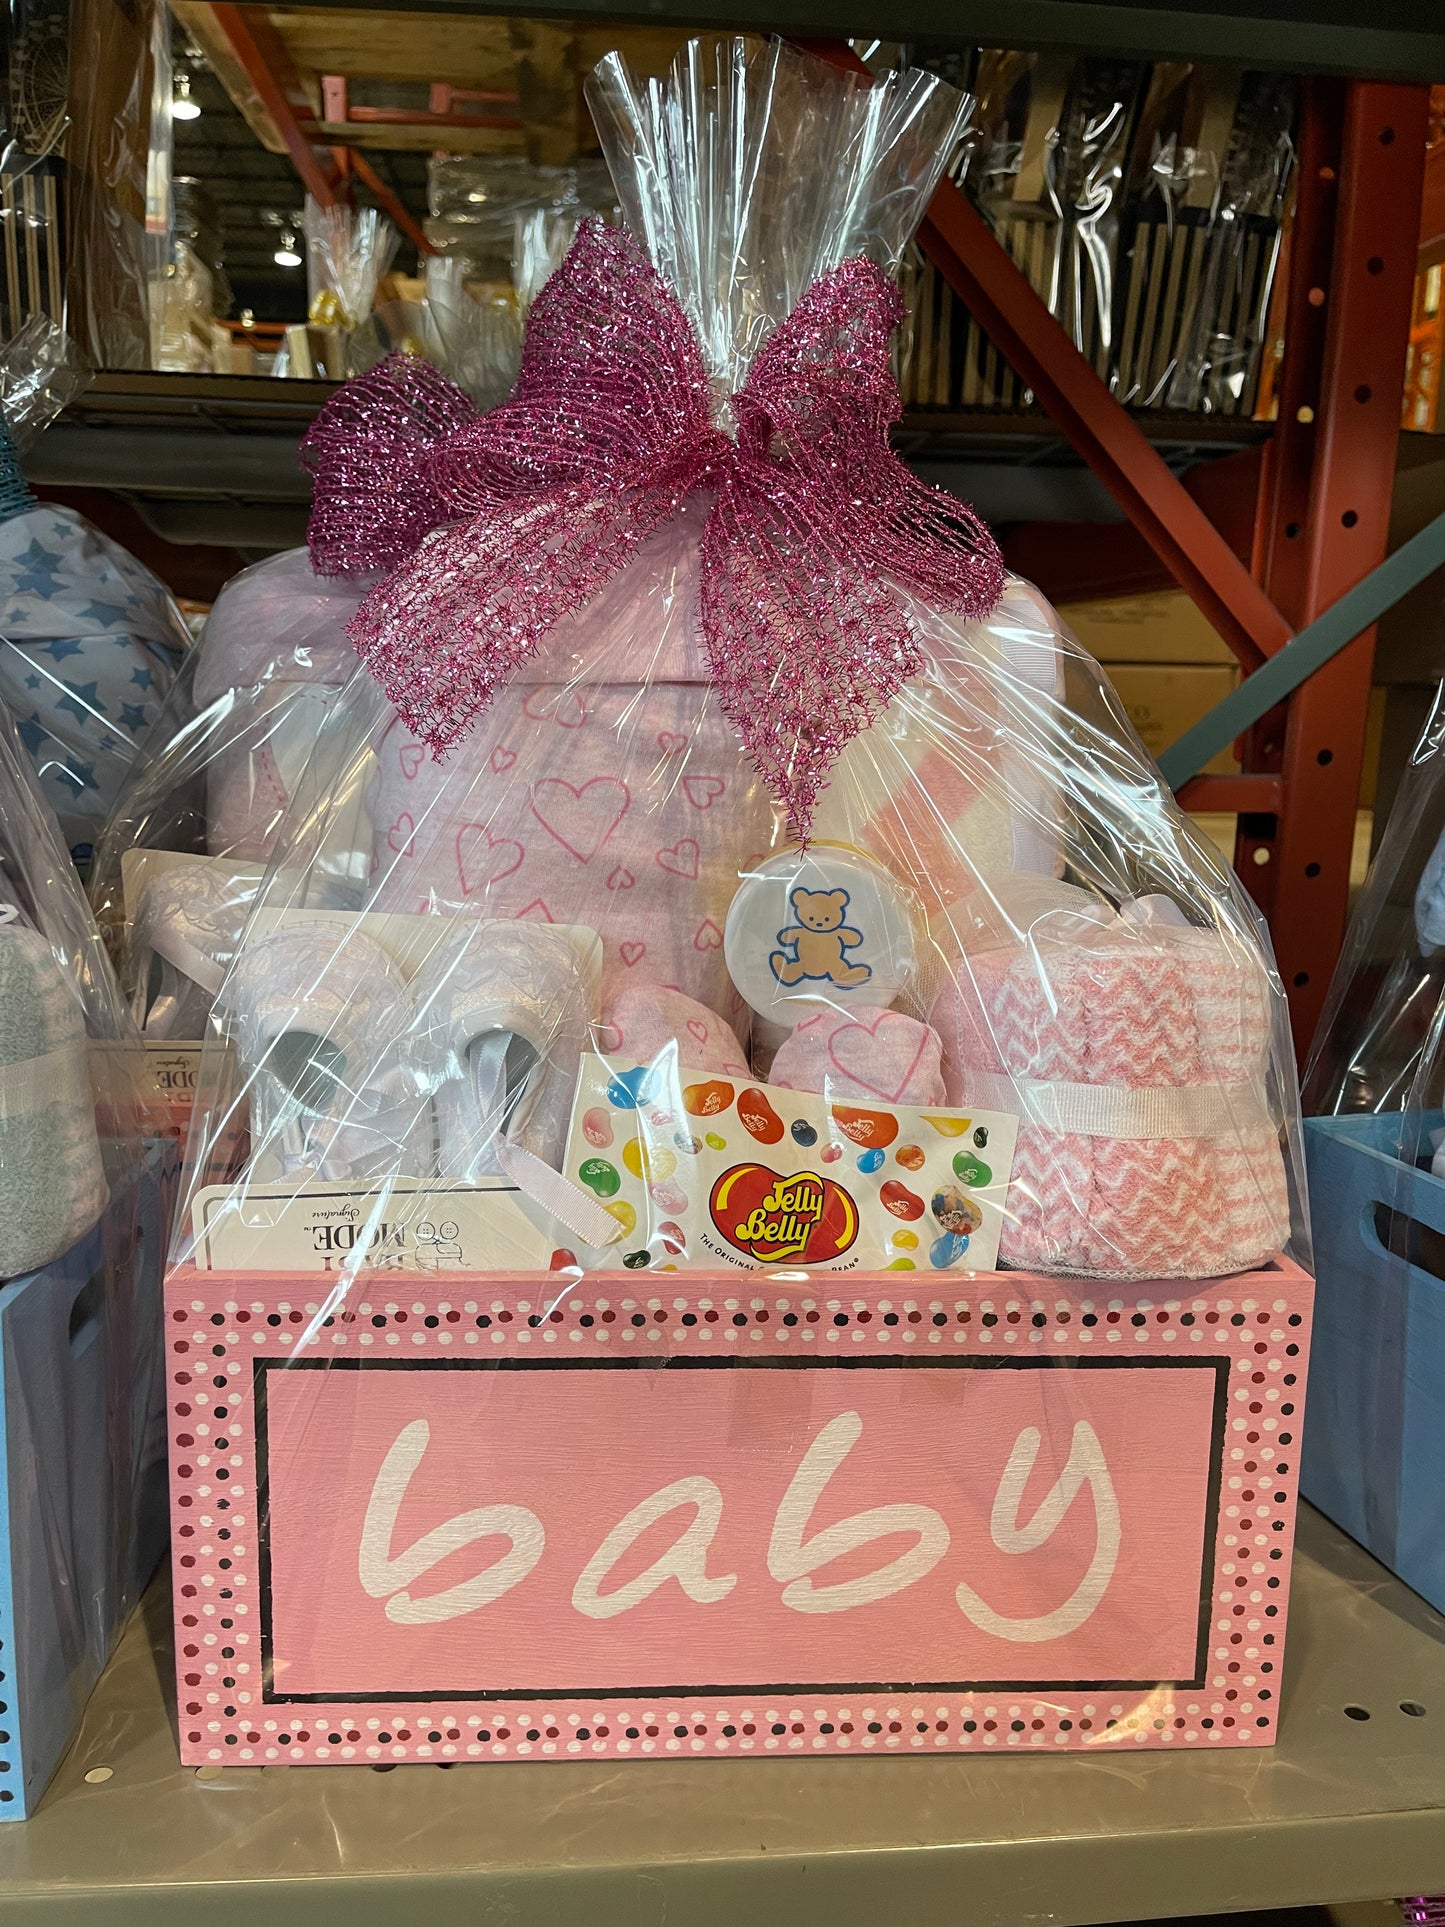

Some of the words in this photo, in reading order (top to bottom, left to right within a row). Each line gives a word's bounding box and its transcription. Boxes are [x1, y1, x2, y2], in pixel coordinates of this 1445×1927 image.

[842, 1122, 869, 1141] Belly
[851, 1118, 874, 1137] Jelly
[312, 1203, 360, 1222] Signature
[763, 1171, 825, 1221] Jelly
[699, 1233, 714, 1249] THE
[714, 1247, 755, 1271] ORIGINAL
[735, 1208, 811, 1262] Belly
[358, 1411, 1122, 1643] baby
